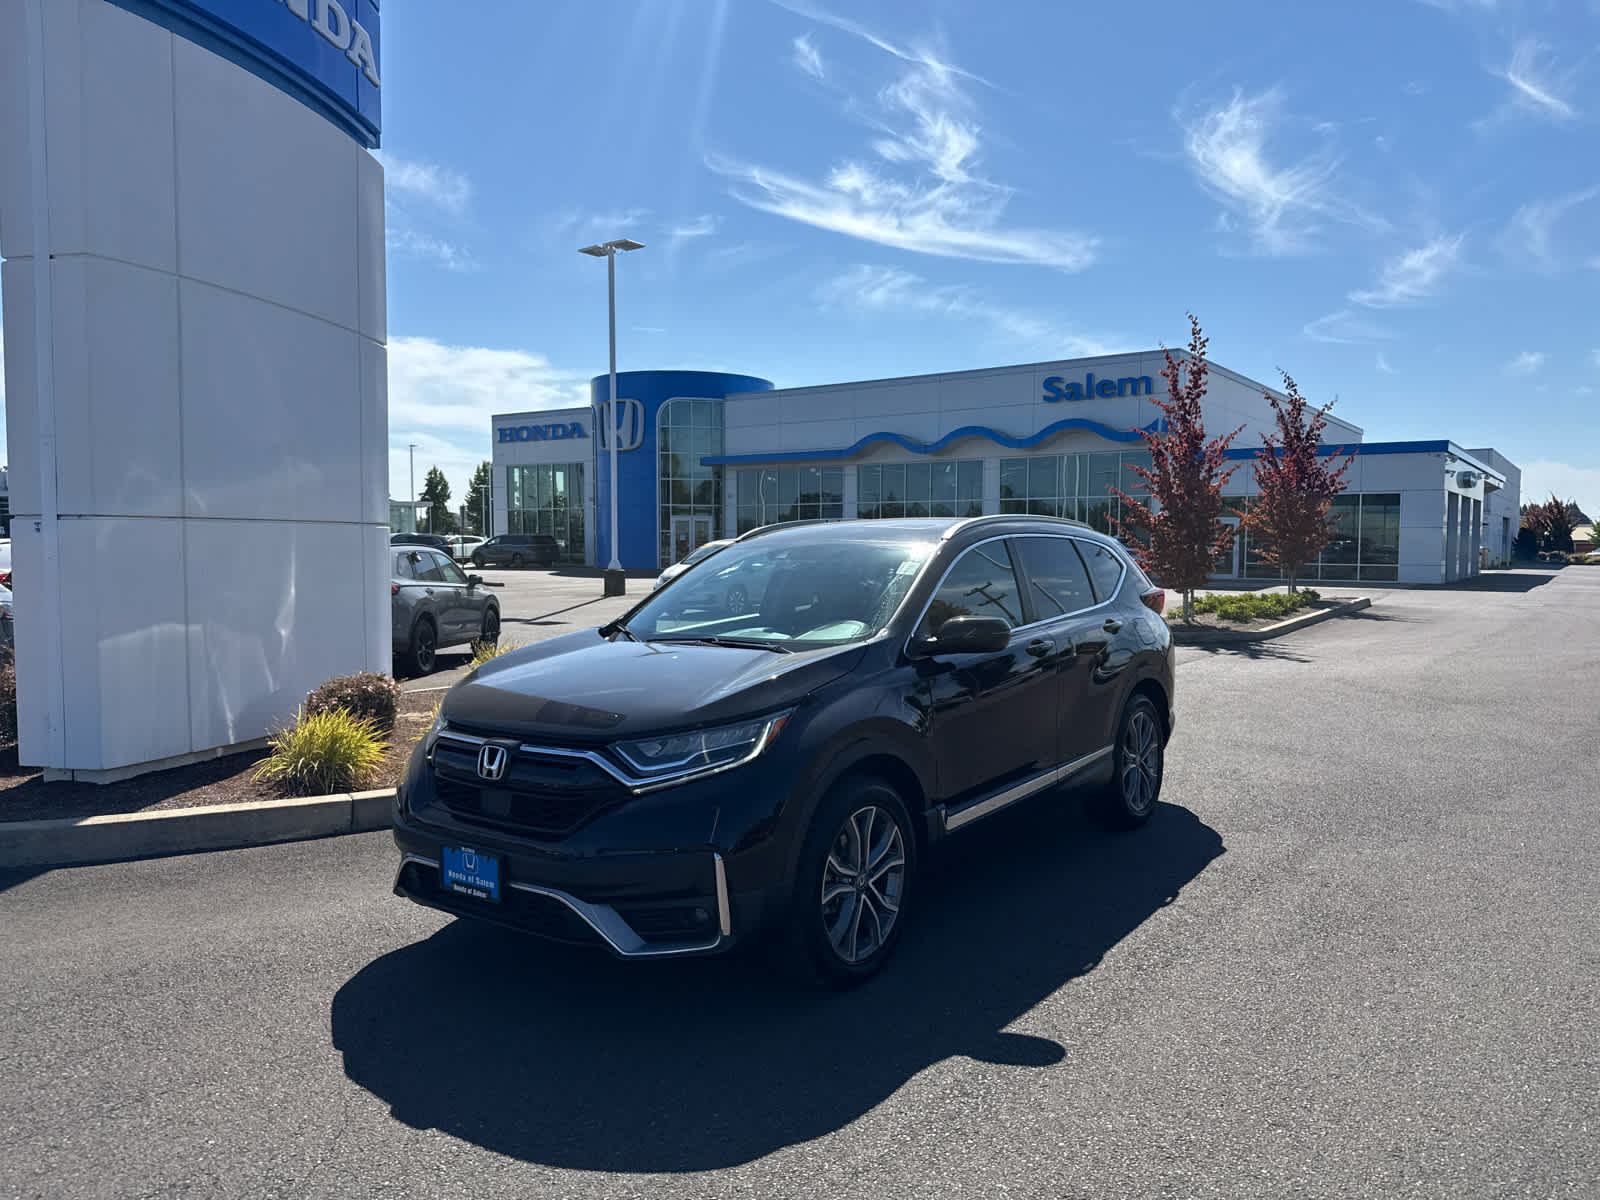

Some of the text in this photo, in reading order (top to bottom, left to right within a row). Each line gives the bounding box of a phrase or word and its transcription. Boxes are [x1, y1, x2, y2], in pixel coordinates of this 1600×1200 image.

[1042, 373, 1152, 402] Salem
[497, 422, 587, 443] HONDA
[448, 870, 466, 881] Honda
[475, 876, 495, 888] Salem
